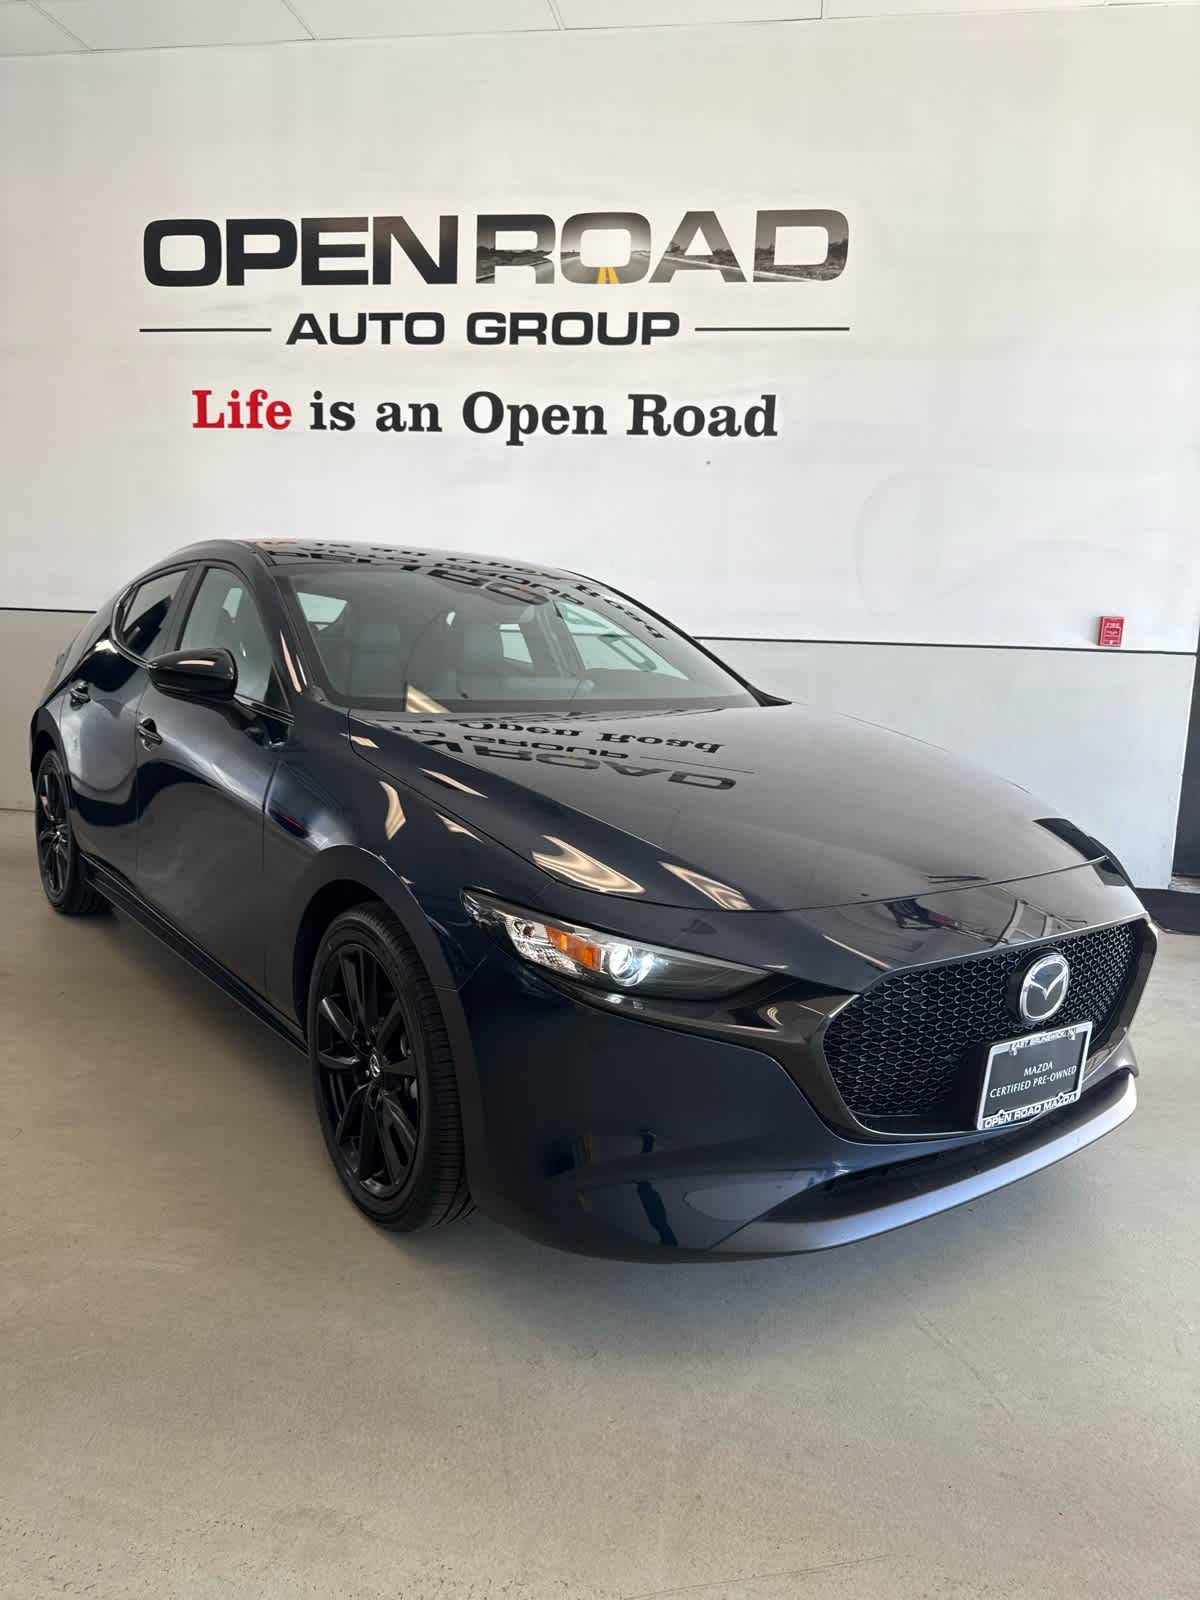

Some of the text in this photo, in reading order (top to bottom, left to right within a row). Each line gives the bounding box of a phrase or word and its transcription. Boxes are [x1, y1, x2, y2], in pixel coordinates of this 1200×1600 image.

[143, 208, 850, 287] OPEN ROAD
[286, 311, 680, 346] AUTO GROUP
[191, 388, 778, 447] Life is an Open Road
[990, 1065, 1077, 1098] CERTIFIED PRE-OWNED
[1023, 1061, 1053, 1076] MAZDA
[984, 1094, 1075, 1128] OPEN ROAD MAZDA
